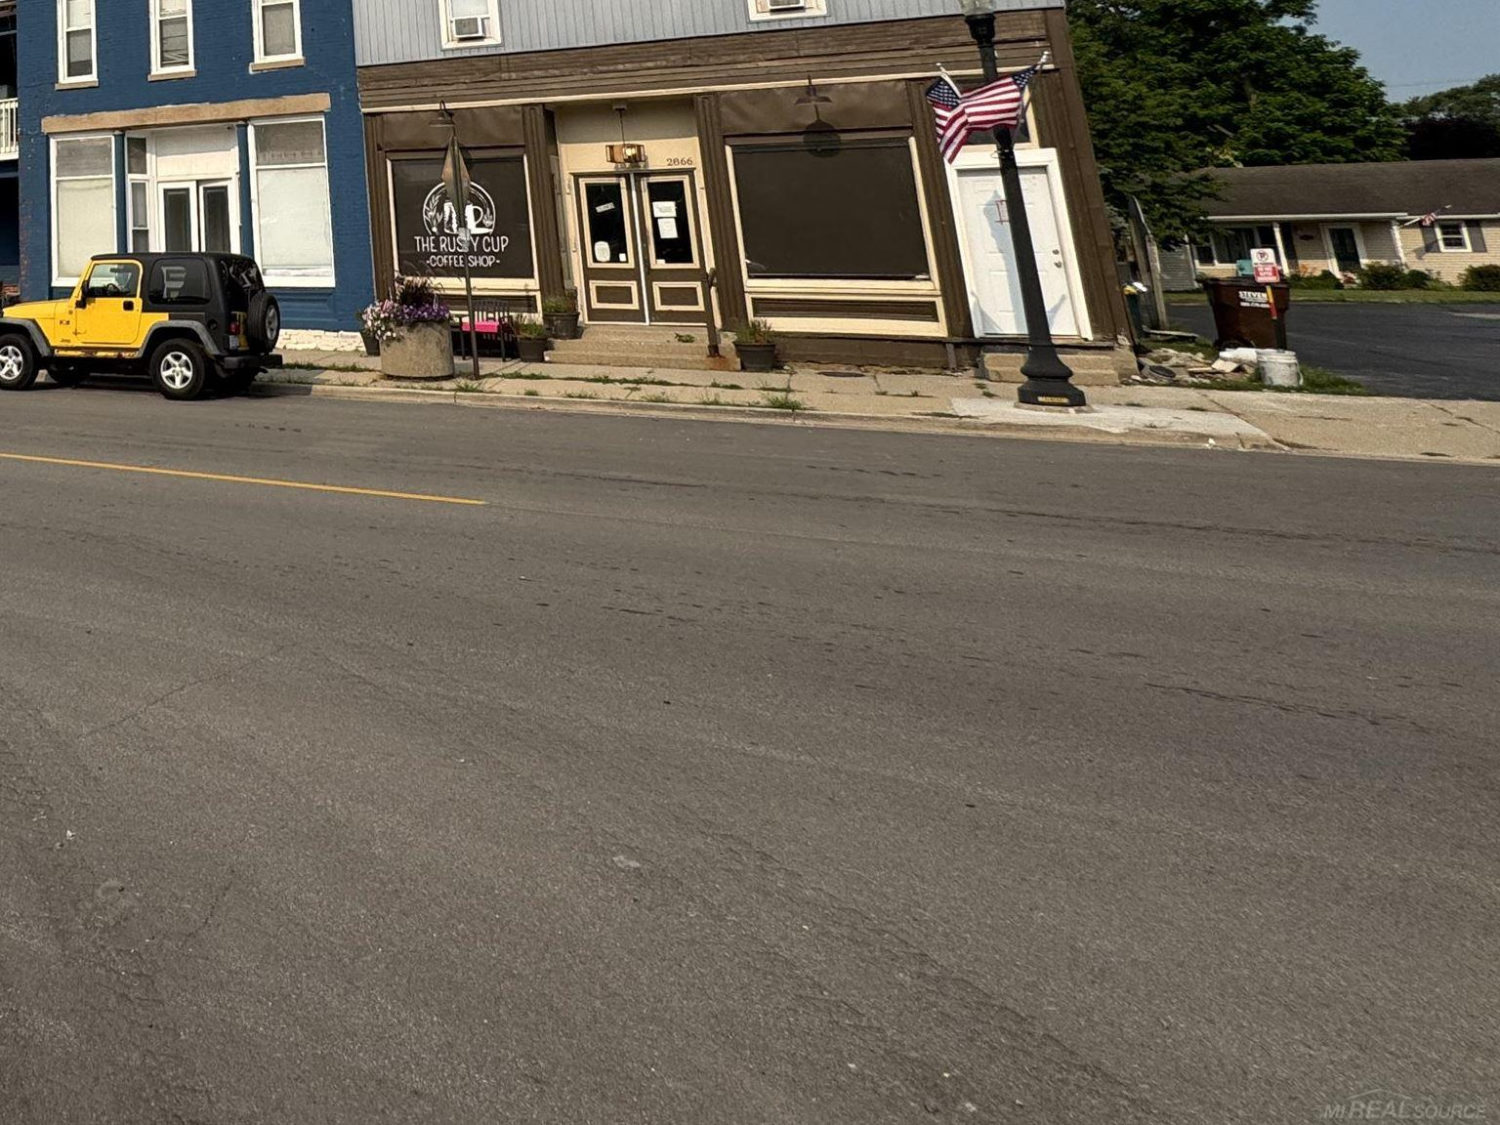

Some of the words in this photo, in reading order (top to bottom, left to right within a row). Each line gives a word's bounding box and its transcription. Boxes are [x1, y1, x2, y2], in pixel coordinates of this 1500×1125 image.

[666, 157, 693, 166] 2866
[414, 236, 437, 252] THE
[440, 236, 479, 252] RUSY
[482, 236, 509, 252] CUP
[1238, 290, 1268, 300] STEVEN
